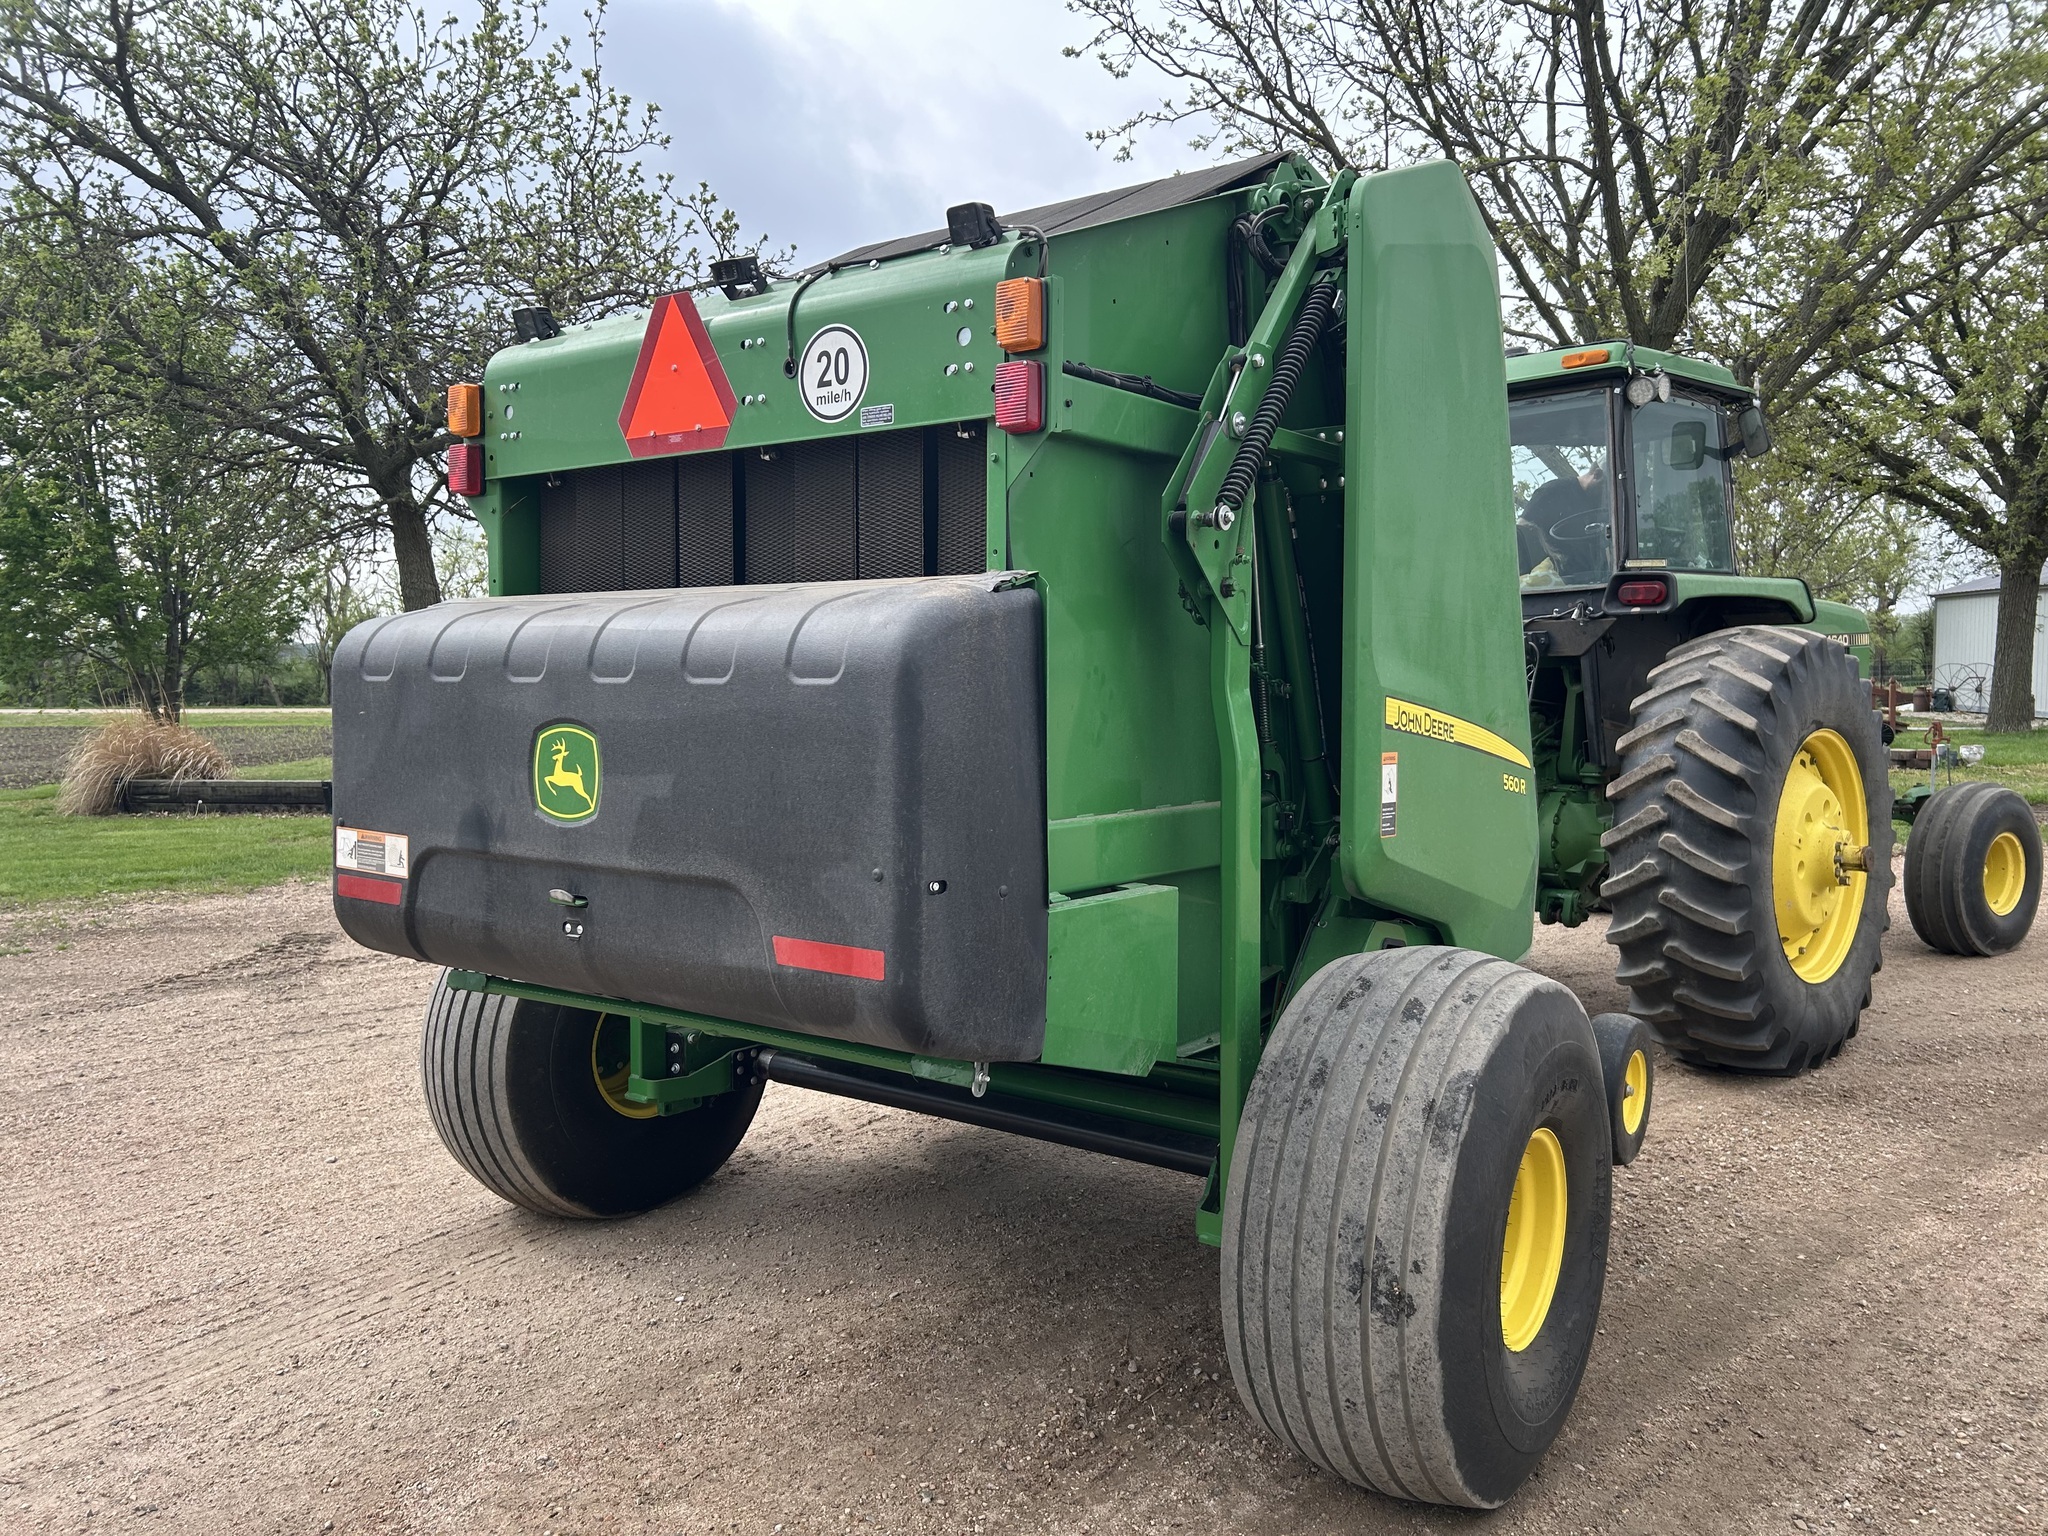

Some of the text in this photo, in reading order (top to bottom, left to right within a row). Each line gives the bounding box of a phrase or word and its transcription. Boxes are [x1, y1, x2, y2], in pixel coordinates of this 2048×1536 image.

[816, 347, 850, 389] 20
[816, 388, 852, 406] mile/h
[1394, 705, 1455, 740] JOHN DEERE
[1503, 773, 1527, 795] 560 R
